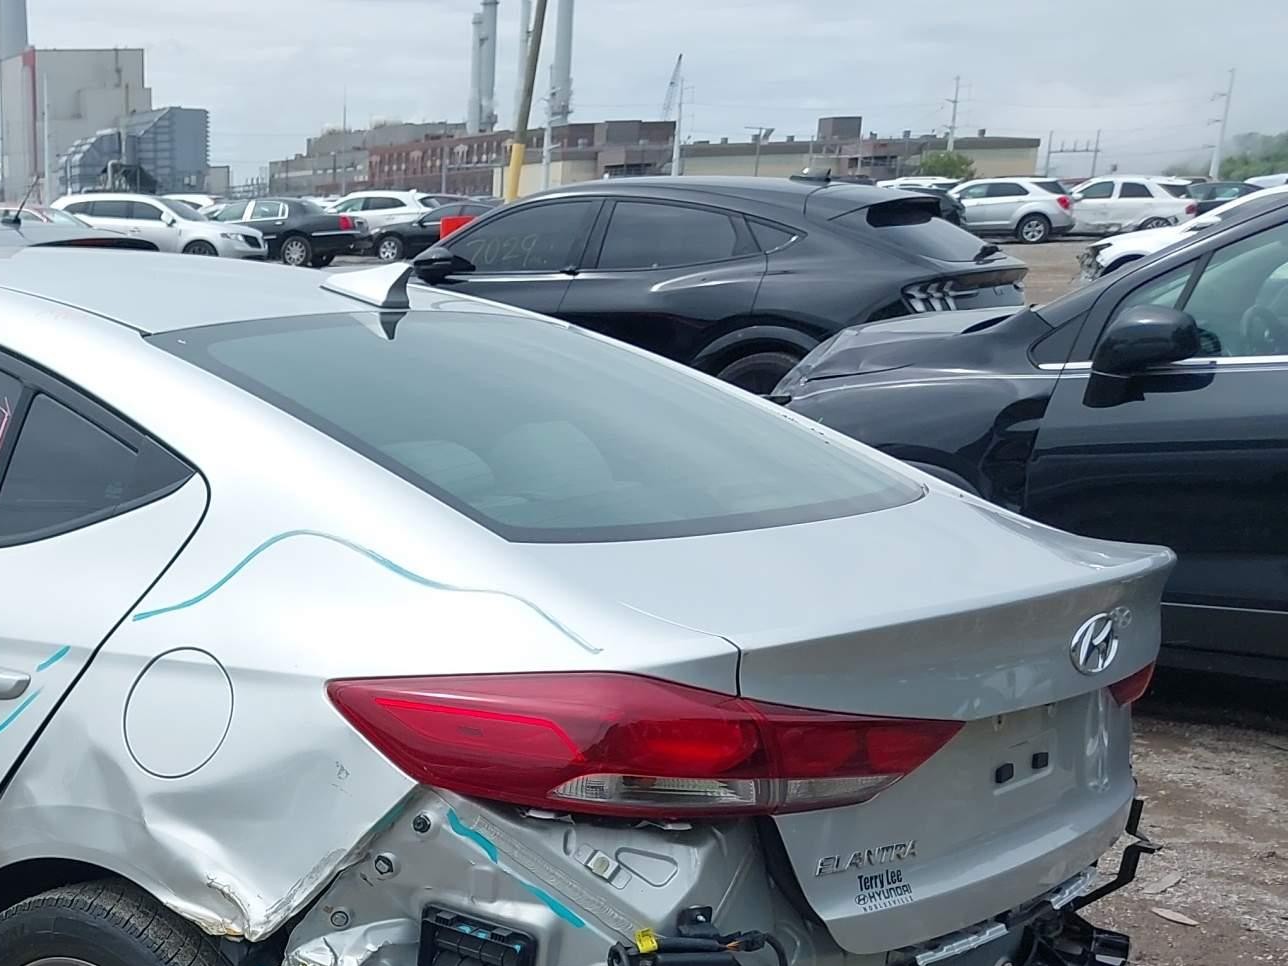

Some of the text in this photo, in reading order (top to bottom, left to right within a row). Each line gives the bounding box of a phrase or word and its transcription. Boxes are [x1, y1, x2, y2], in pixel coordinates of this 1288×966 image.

[815, 839, 917, 877] ELANTRA
[857, 869, 903, 892] Terry Lee
[868, 883, 913, 903] HYUNDAI
